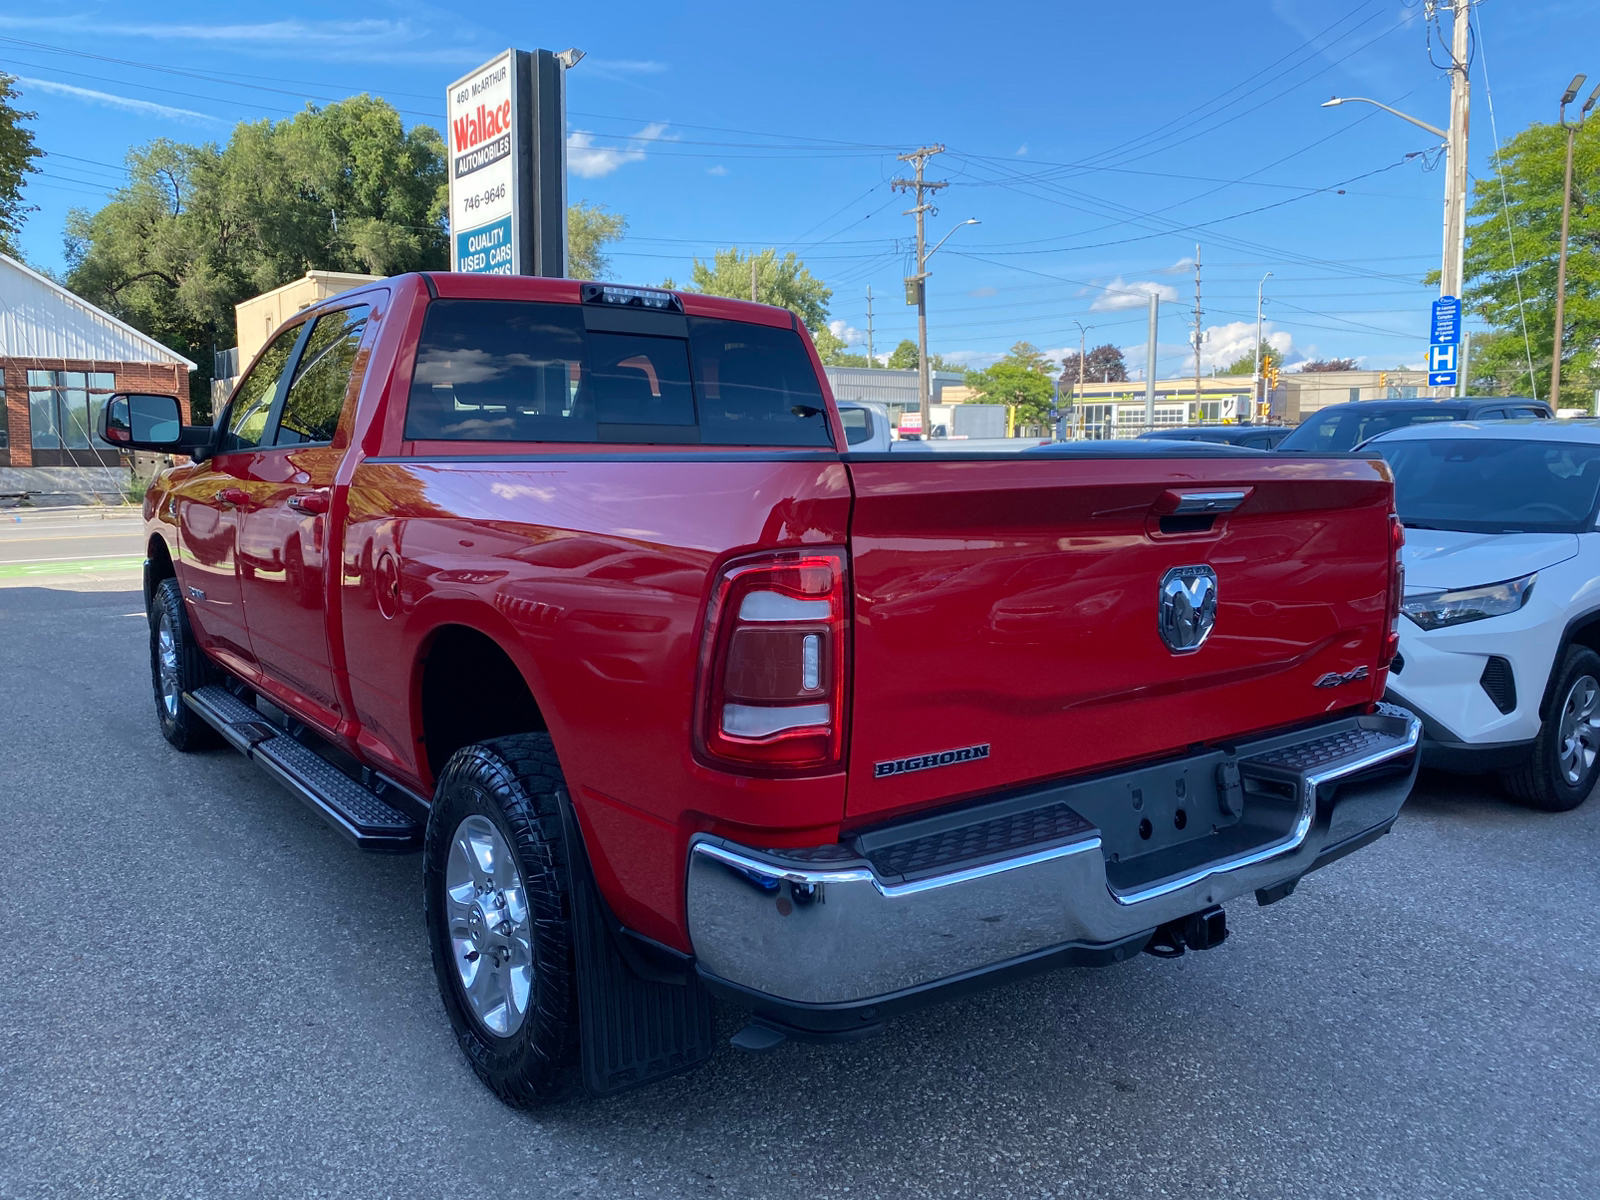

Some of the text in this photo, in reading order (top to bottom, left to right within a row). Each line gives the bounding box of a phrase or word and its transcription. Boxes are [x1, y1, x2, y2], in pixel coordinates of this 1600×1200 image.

[456, 66, 507, 105] 460 McARTHUR
[453, 98, 511, 153] Wallace
[458, 137, 509, 174] AUTOMOBILES
[463, 183, 506, 212] 746-9646
[468, 226, 504, 252] QUALITY
[461, 243, 511, 273] USED CARS
[1432, 345, 1454, 370] H
[874, 742, 990, 778] BIGHORN
